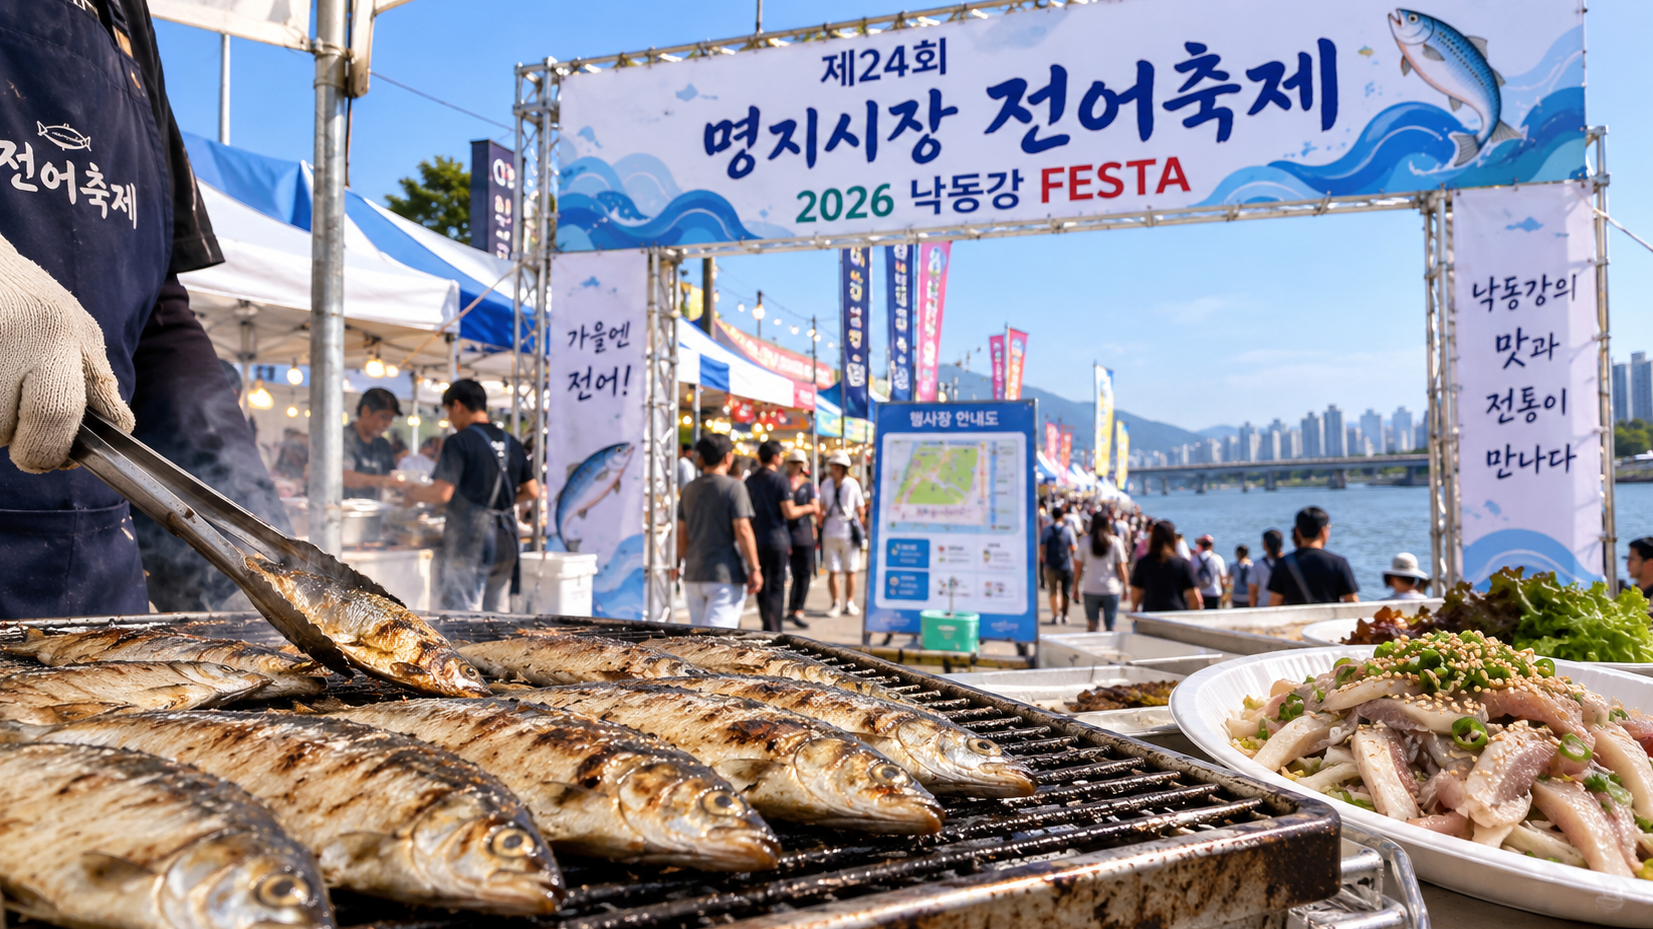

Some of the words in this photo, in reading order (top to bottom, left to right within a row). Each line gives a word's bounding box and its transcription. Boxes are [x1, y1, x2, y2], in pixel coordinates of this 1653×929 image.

[821, 37, 947, 87] 제24회
[703, 89, 958, 180] 명지시장
[984, 37, 1338, 154] 전어축제
[0, 140, 137, 230] 전어축제
[795, 183, 894, 224] 2026
[910, 169, 1024, 216] 낙동강
[1040, 156, 1192, 203] FESTA
[1472, 273, 1577, 312] 낙동강의
[567, 320, 630, 354] 가을엔
[1496, 327, 1560, 370] 맛과
[567, 364, 631, 402] 전어!
[1486, 385, 1567, 424] 전통이
[1486, 443, 1577, 479] 만나다
